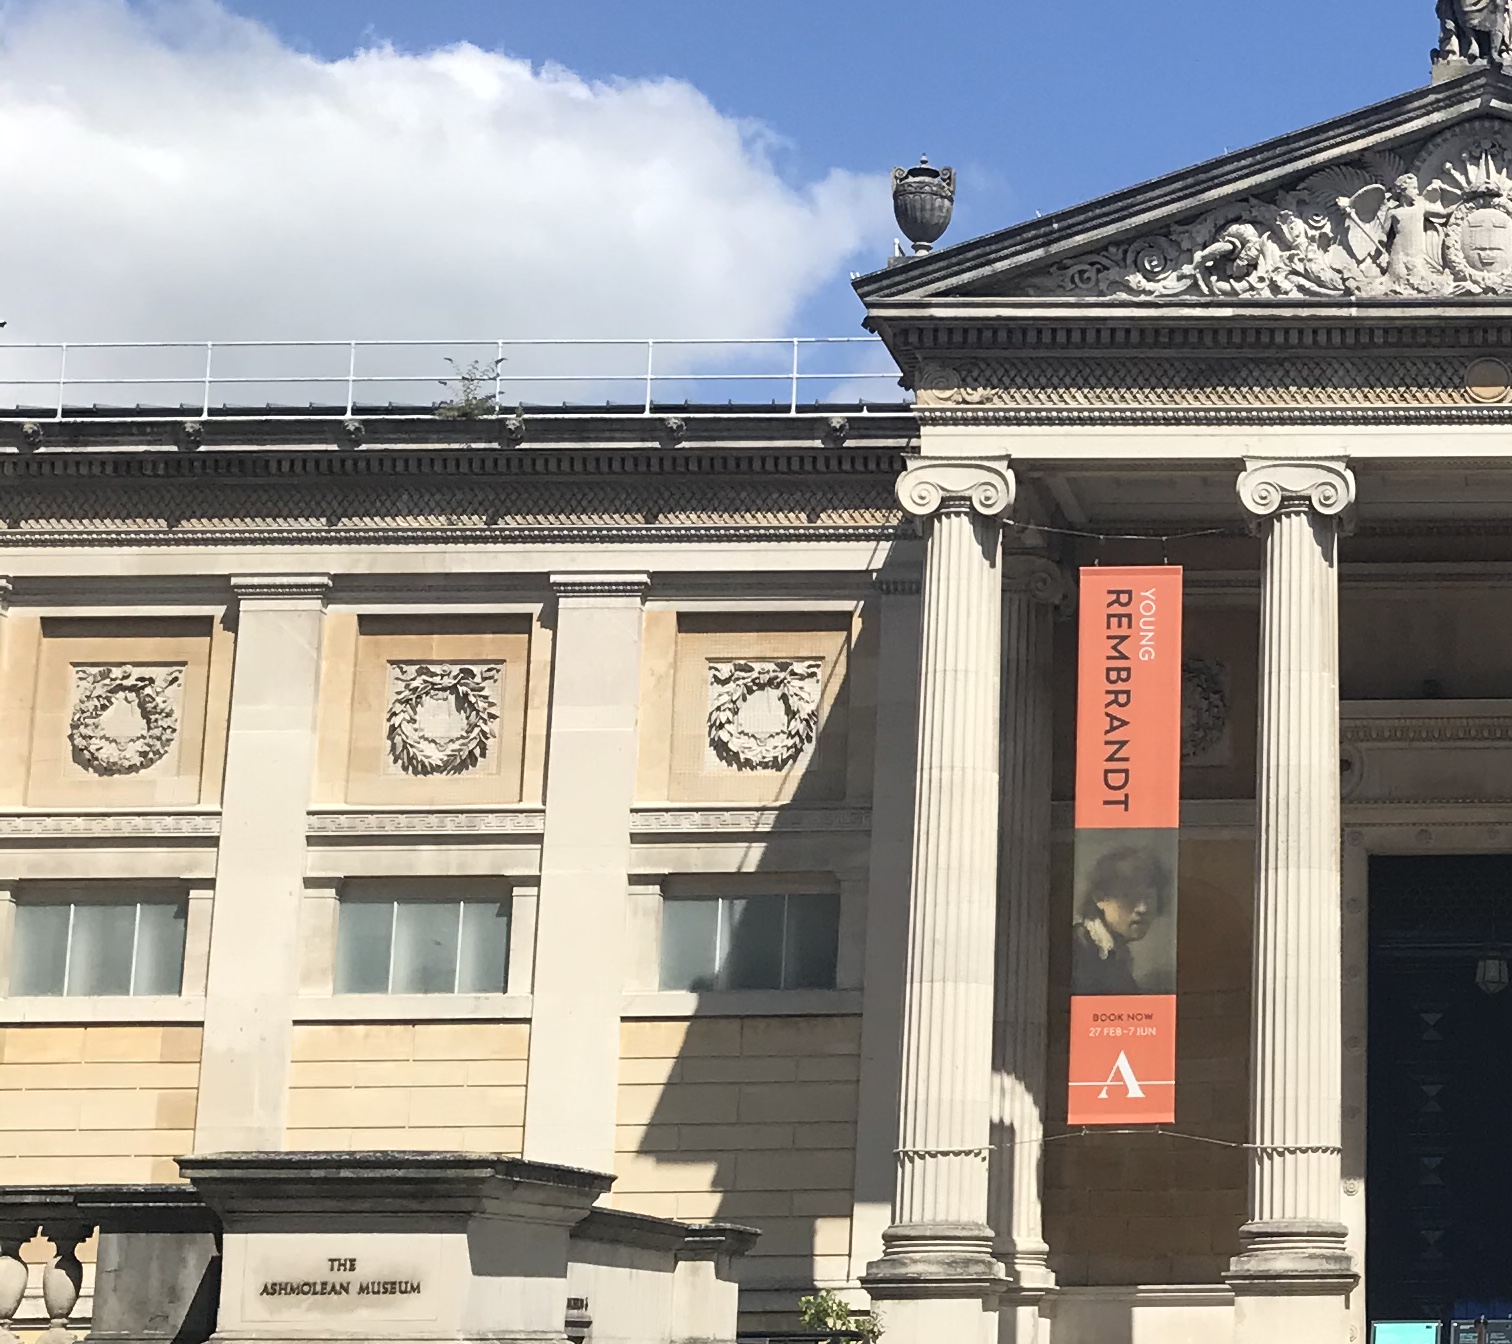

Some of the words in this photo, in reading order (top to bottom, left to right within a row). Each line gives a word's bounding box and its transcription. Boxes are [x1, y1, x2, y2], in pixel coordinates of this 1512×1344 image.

[1139, 587, 1156, 661] YOUNG
[1102, 589, 1132, 811] REMBRANDT
[1093, 1014, 1124, 1022] BOOK
[1127, 1013, 1153, 1022] NOW
[1089, 1028, 1101, 1037] 27
[1136, 1027, 1156, 1036] JUN
[1097, 1049, 1146, 1098] A
[328, 1258, 356, 1272] THE
[260, 1281, 350, 1296] ASHMOLEAN
[357, 1280, 421, 1295] MUSEUM
